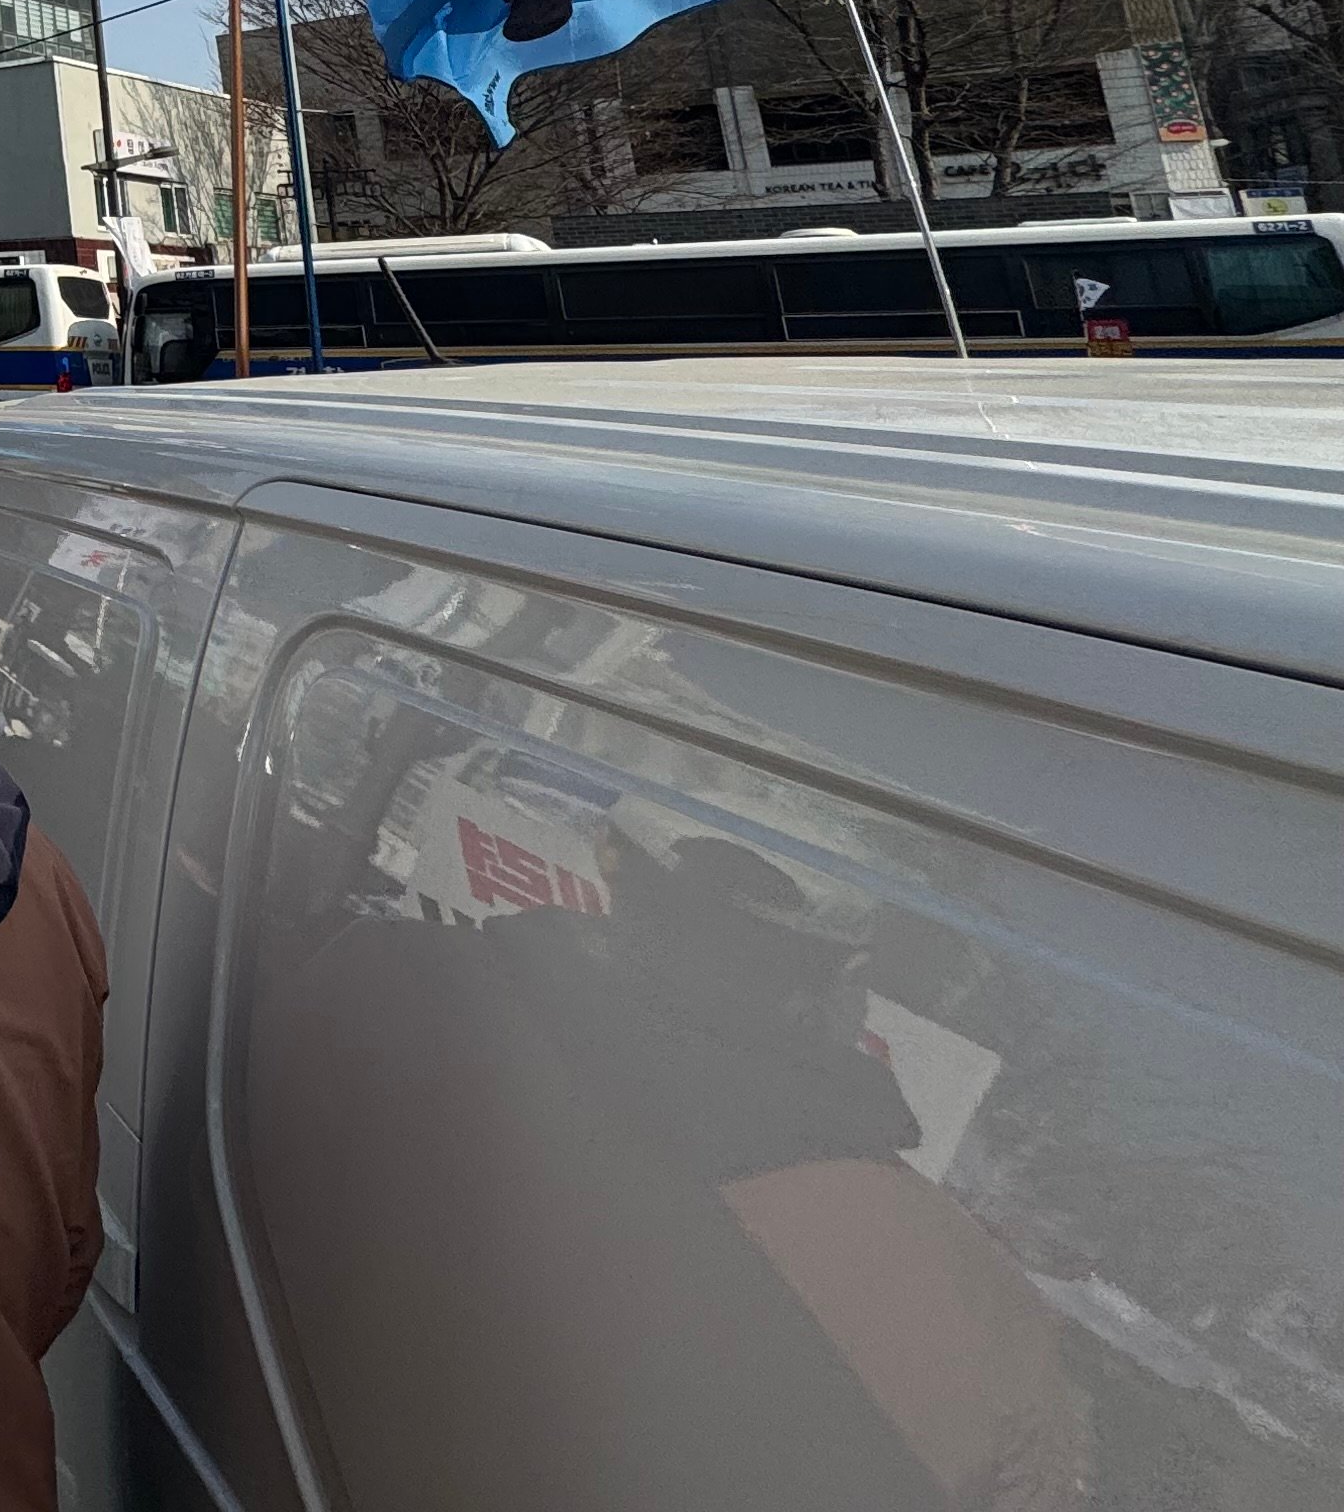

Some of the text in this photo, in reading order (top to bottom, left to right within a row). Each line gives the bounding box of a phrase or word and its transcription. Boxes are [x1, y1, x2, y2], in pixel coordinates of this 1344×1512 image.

[943, 164, 991, 178] CAFE
[765, 181, 815, 194] KOREAN
[818, 181, 844, 192] TEA
[846, 181, 855, 191] &
